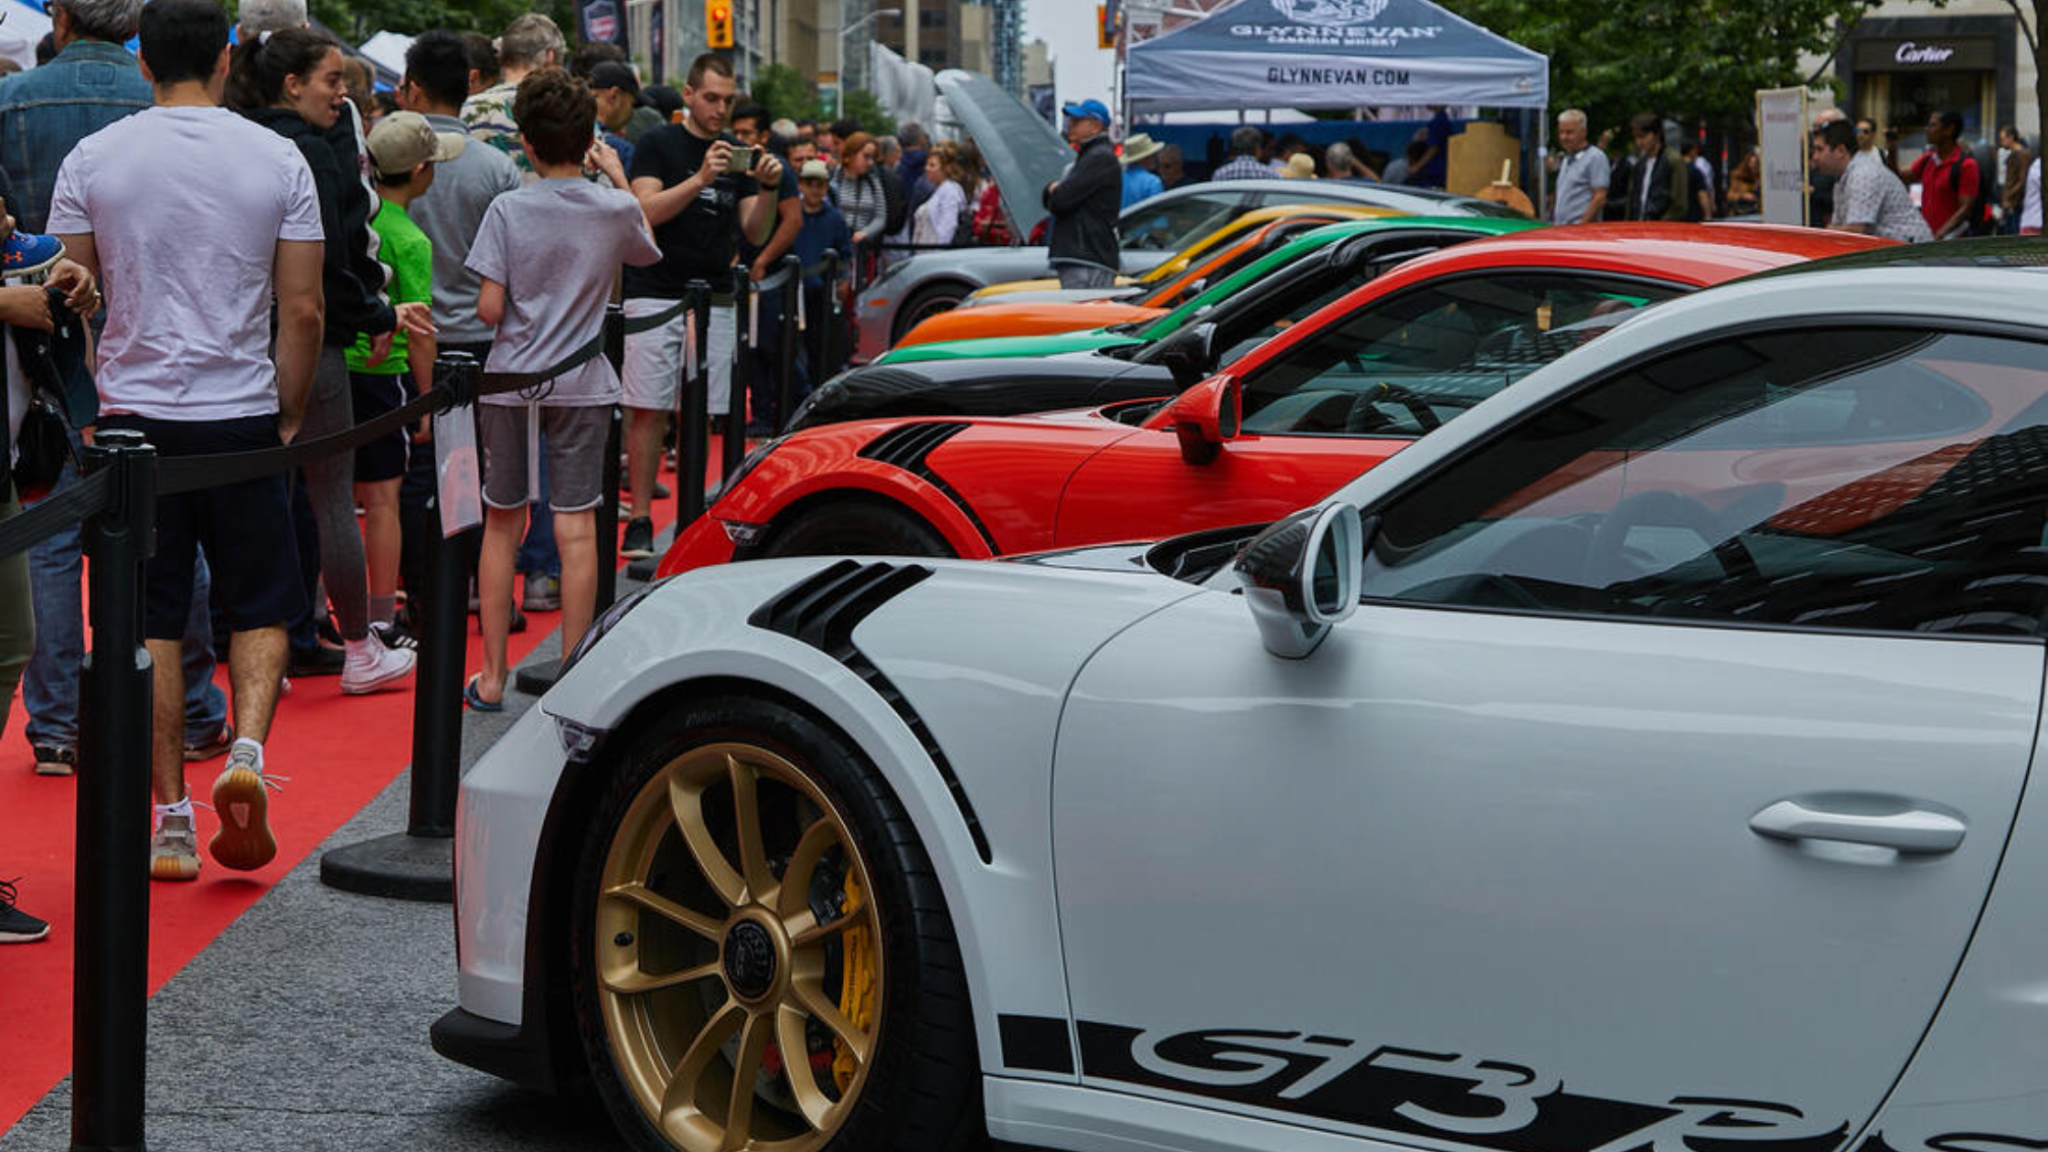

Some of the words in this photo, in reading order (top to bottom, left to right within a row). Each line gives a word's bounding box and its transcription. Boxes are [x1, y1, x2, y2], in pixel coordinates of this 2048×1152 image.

[1230, 25, 1440, 38] GLYNNEVAN
[1267, 35, 1340, 45] CANADIAN
[1343, 37, 1399, 47] WHISKY
[1894, 41, 1954, 64] Cartier
[1267, 67, 1410, 85] GLYNNEVAN.COM
[1130, 1028, 1545, 1134] GT3
